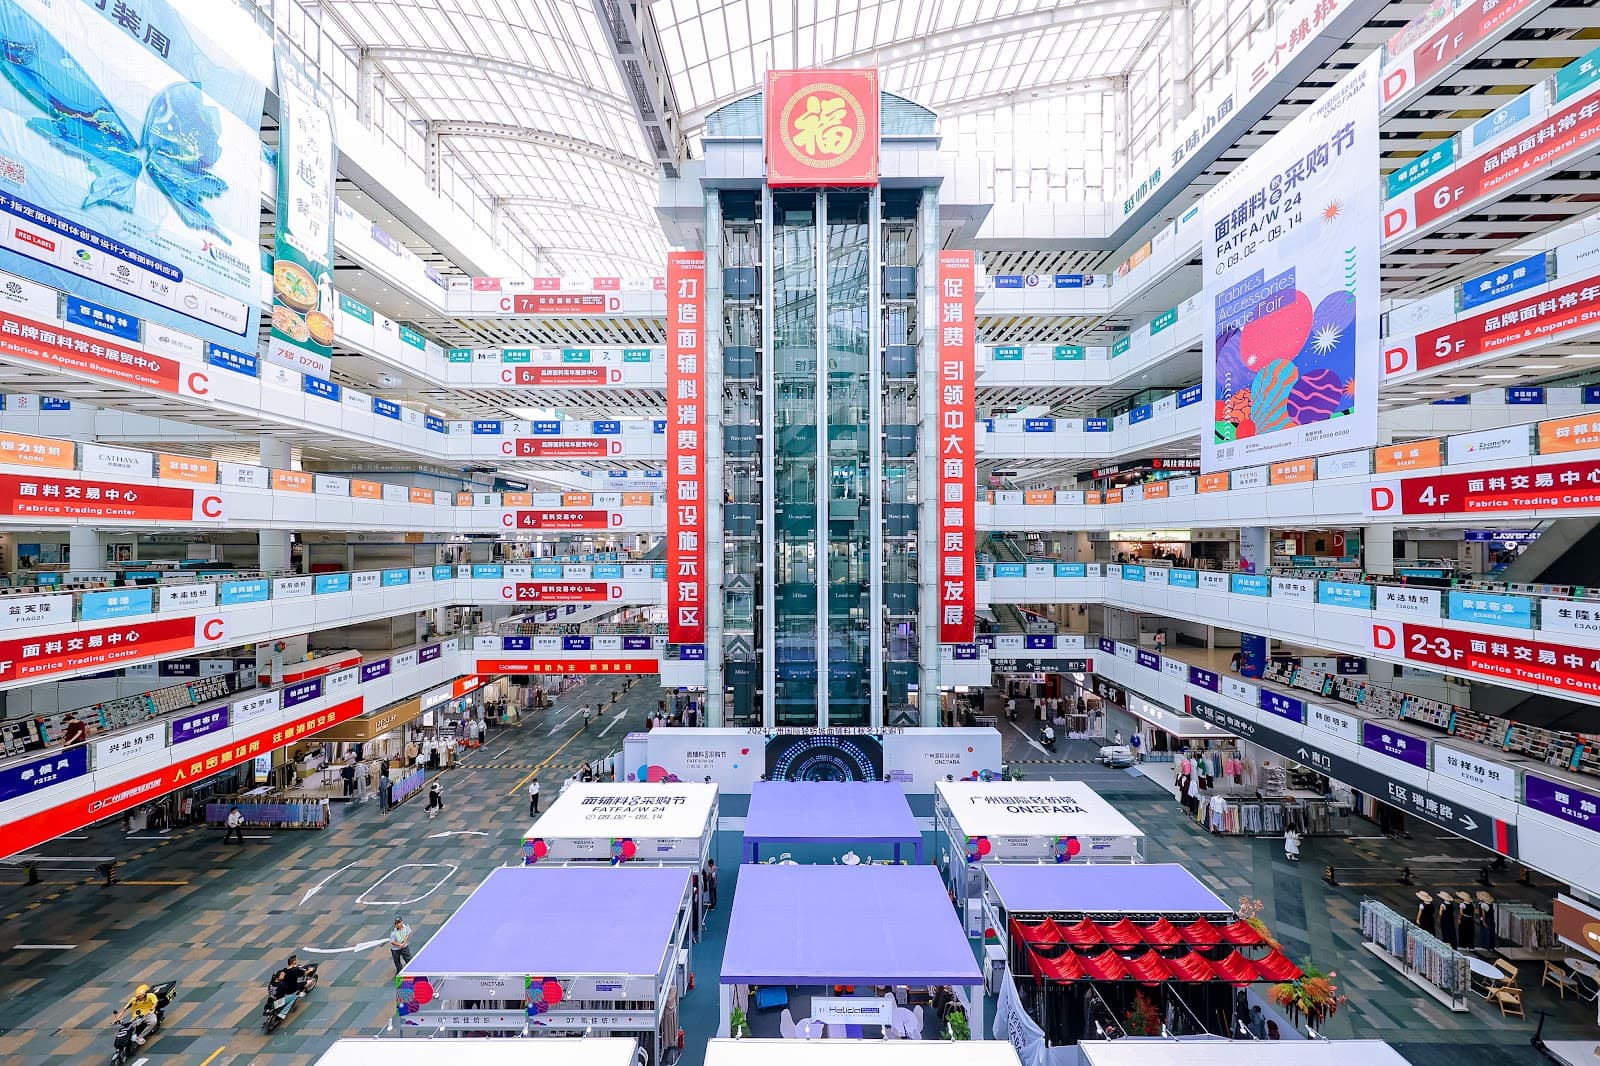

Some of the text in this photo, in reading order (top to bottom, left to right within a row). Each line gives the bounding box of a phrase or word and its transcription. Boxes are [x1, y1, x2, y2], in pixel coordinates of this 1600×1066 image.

[1384, 69, 1407, 103] D
[793, 96, 853, 156] 福
[1484, 167, 1520, 189] Fabrics
[1533, 139, 1576, 164] Apparel
[1433, 186, 1465, 209] 6F
[1384, 208, 1408, 239] D
[1217, 276, 1263, 308] Fabrics
[1217, 273, 1296, 323] Accessories
[500, 298, 511, 311] C
[521, 299, 534, 310] 7F
[609, 298, 621, 311] D
[1218, 294, 1285, 336] Trade Fair
[1485, 285, 1600, 333] 品牌面料常年
[1485, 332, 1521, 349] Fabrics
[1534, 316, 1578, 335] Apparel
[2, 319, 161, 373] 品牌面料常年展贸中心
[1435, 334, 1466, 358] 5F
[1, 340, 39, 360] Fabrics
[52, 353, 89, 369] Apparel
[90, 363, 134, 380] Showroom
[135, 374, 160, 386] Center
[1385, 347, 1409, 375] D
[188, 372, 209, 395] C
[502, 369, 512, 383] C
[522, 371, 535, 382] 6F
[611, 369, 622, 383] D
[502, 441, 513, 454] C
[523, 443, 536, 454] 5F
[611, 441, 622, 454] D
[676, 277, 700, 627] 打造面辅料消费基础设施示范区
[943, 277, 965, 626] 促消费 引领中大商圈高质量发展
[98, 454, 139, 465] CATHAYA
[19, 482, 138, 502] 面料交易中心
[1370, 487, 1394, 511] D
[1418, 485, 1450, 507] 4F
[1469, 499, 1509, 509] Fabrics
[1513, 496, 1558, 507] Trading
[18, 504, 137, 517] Fabrics Trading Center
[201, 496, 223, 518] C
[502, 514, 513, 527] C
[523, 515, 537, 526] 4F
[612, 514, 623, 527] D
[502, 585, 513, 599] C
[519, 588, 540, 599] 2-3F
[612, 585, 623, 599] D
[203, 618, 224, 641] C
[1373, 624, 1397, 651] D
[22, 629, 141, 659] 面料交易中心
[1410, 634, 1464, 661] 2-3F
[21, 648, 140, 675] Fabrics Trading Center
[1471, 660, 1512, 675] Fabrics
[1514, 668, 1563, 686] Trading
[172, 739, 261, 783] 人员密集场所
